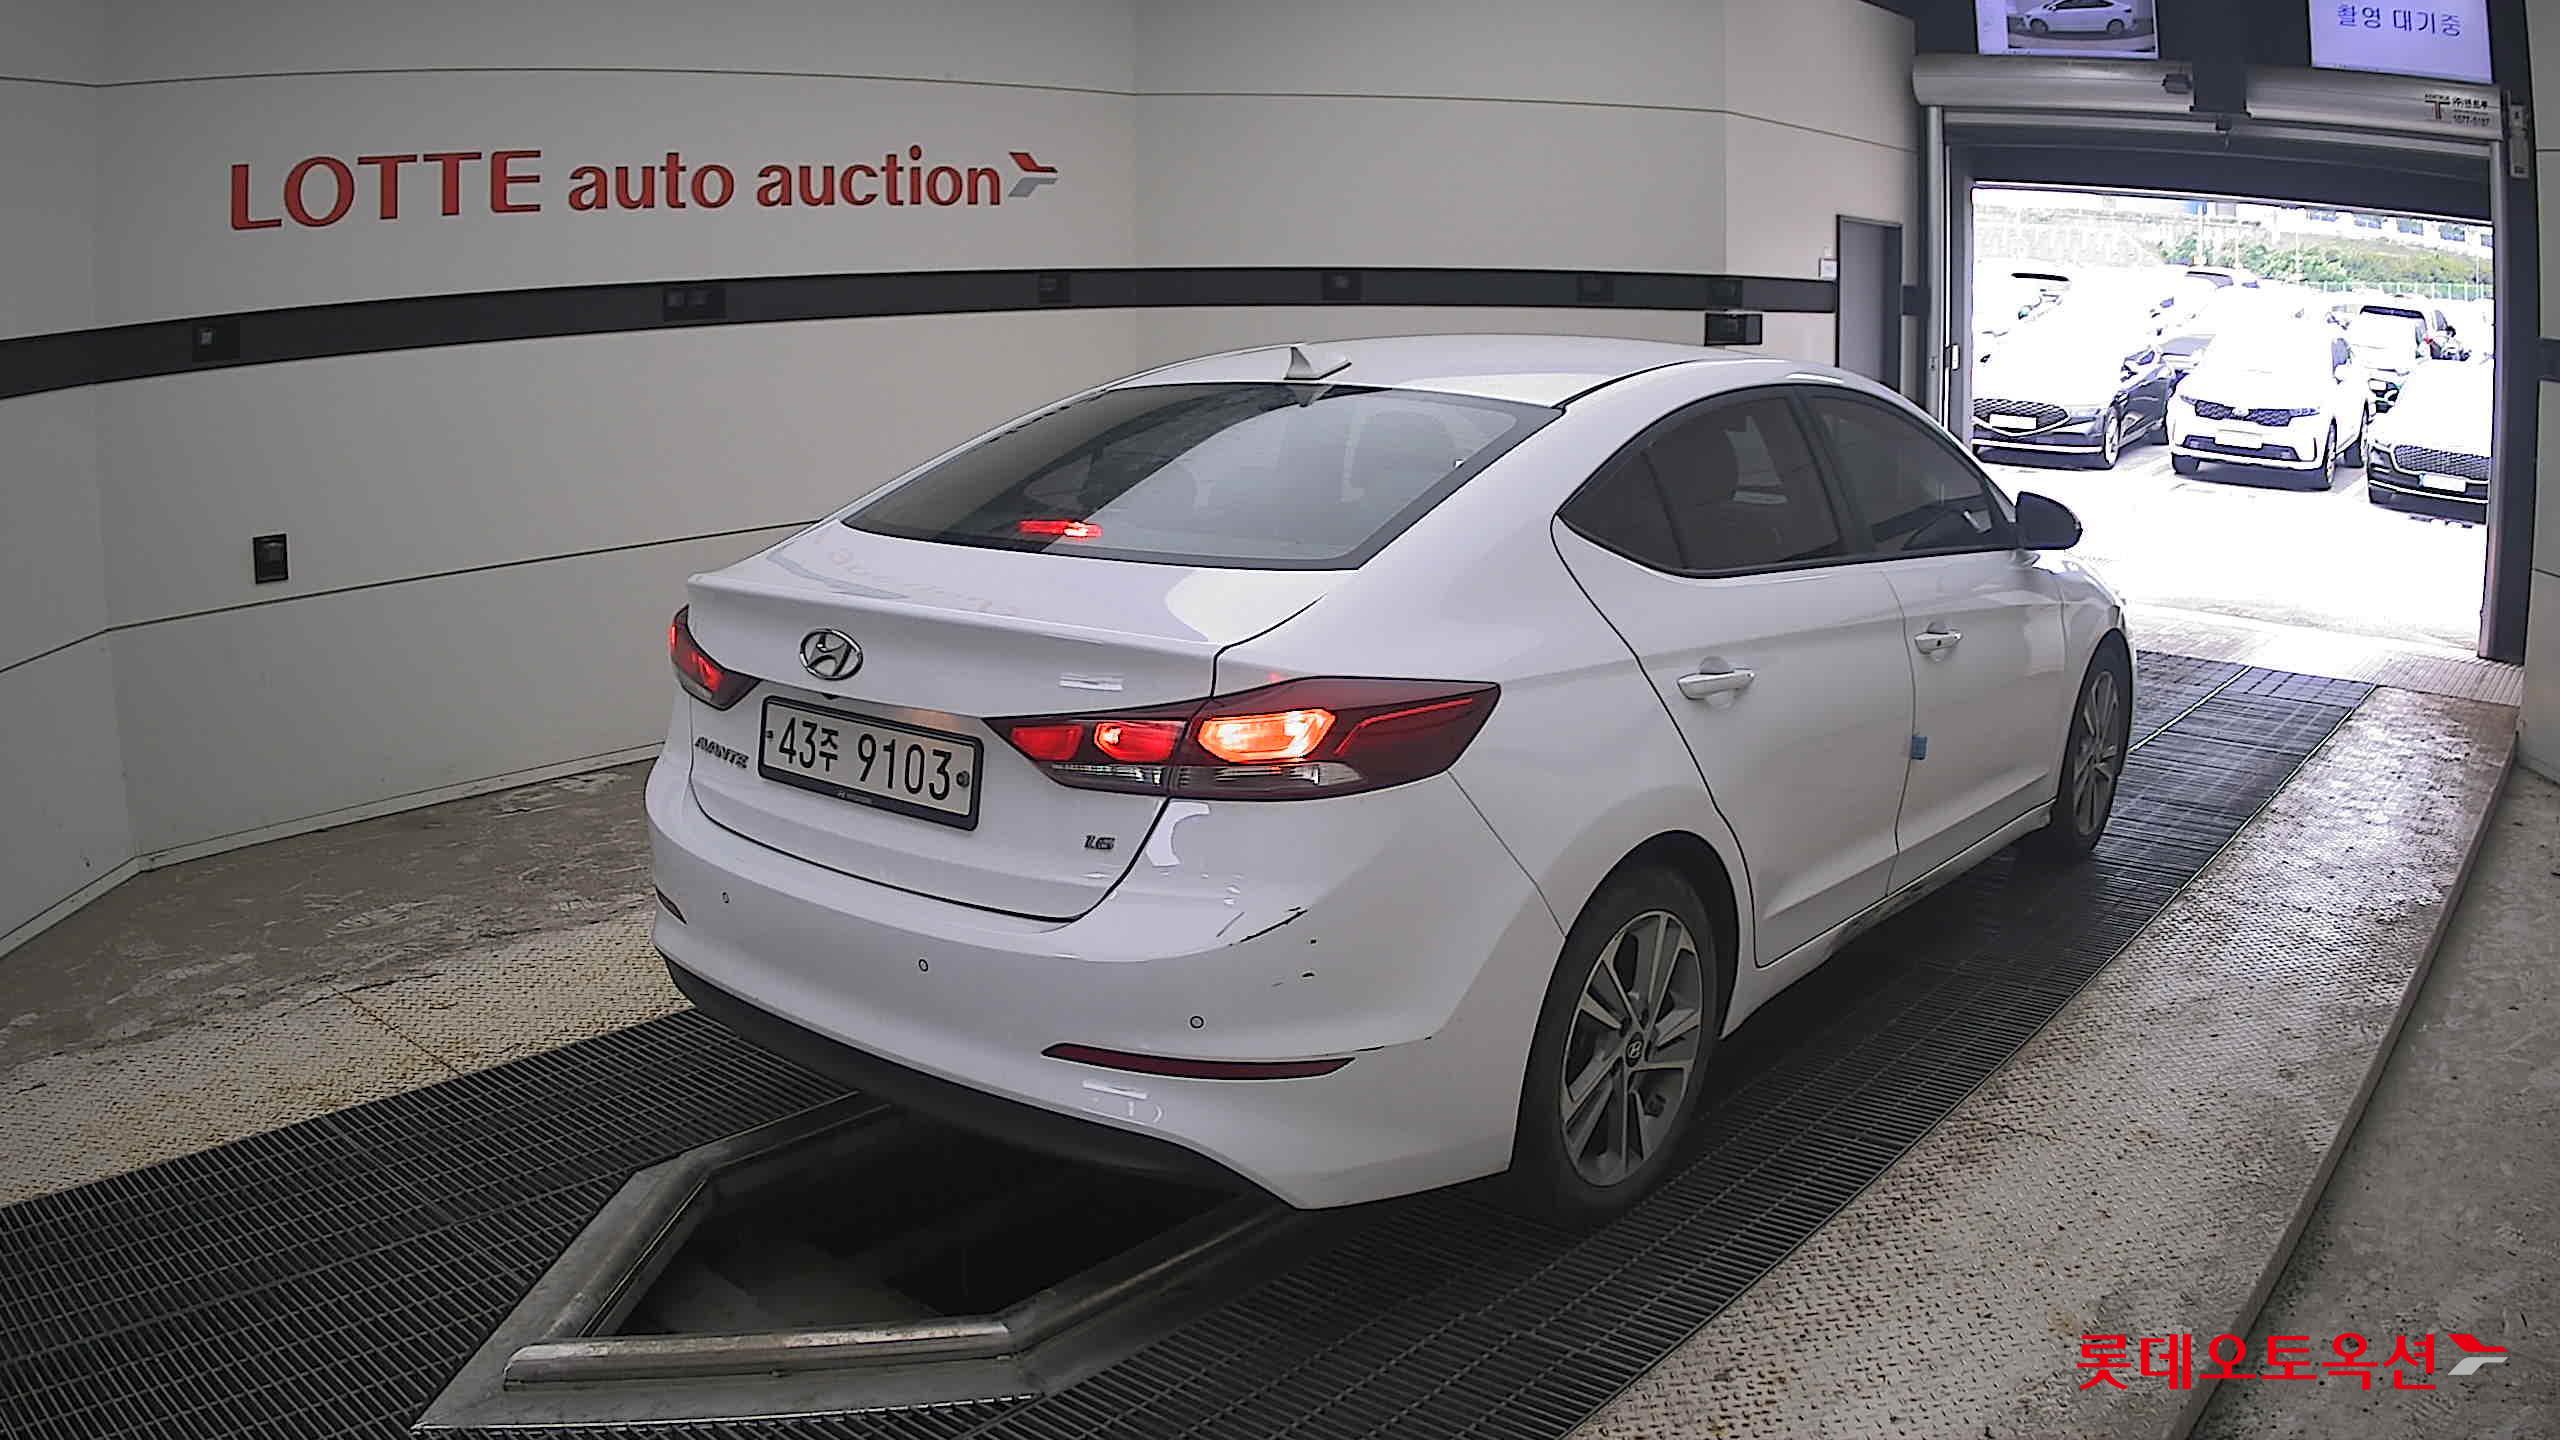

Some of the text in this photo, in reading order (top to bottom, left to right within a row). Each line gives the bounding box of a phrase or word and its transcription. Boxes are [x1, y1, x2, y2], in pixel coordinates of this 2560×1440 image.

[2338, 4, 2461, 37] 촬영 대기중
[231, 145, 1000, 230] LOTTE auto auction
[778, 716, 952, 801] 43주 9103
